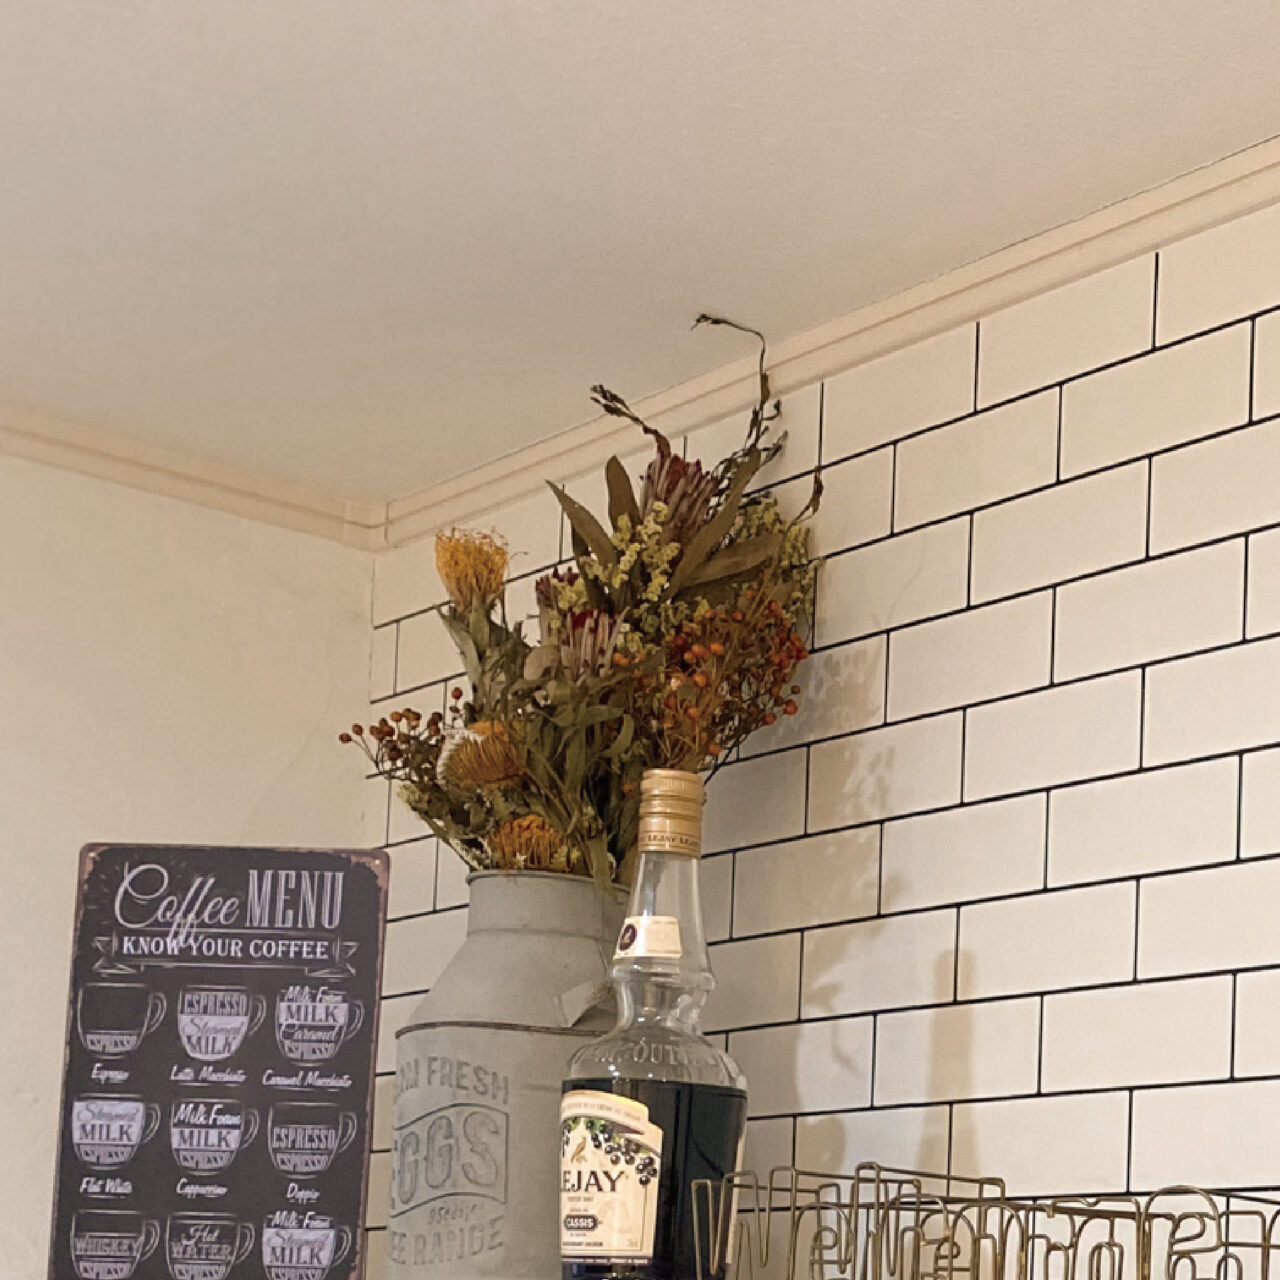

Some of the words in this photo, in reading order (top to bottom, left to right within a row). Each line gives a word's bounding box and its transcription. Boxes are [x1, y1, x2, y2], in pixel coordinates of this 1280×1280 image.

[114, 862, 240, 948] Coffee
[244, 869, 345, 929] MENU
[122, 936, 180, 956] KNOW
[189, 936, 243, 957] YOUR
[249, 939, 329, 959] COFFEE
[285, 1004, 340, 1023] MILK
[186, 1034, 238, 1055] MILK
[427, 1056, 509, 1104] FRESH
[80, 1123, 133, 1142] MILK
[178, 1129, 234, 1148] MILK
[393, 1110, 500, 1206] GGS
[270, 1246, 323, 1265] MILK
